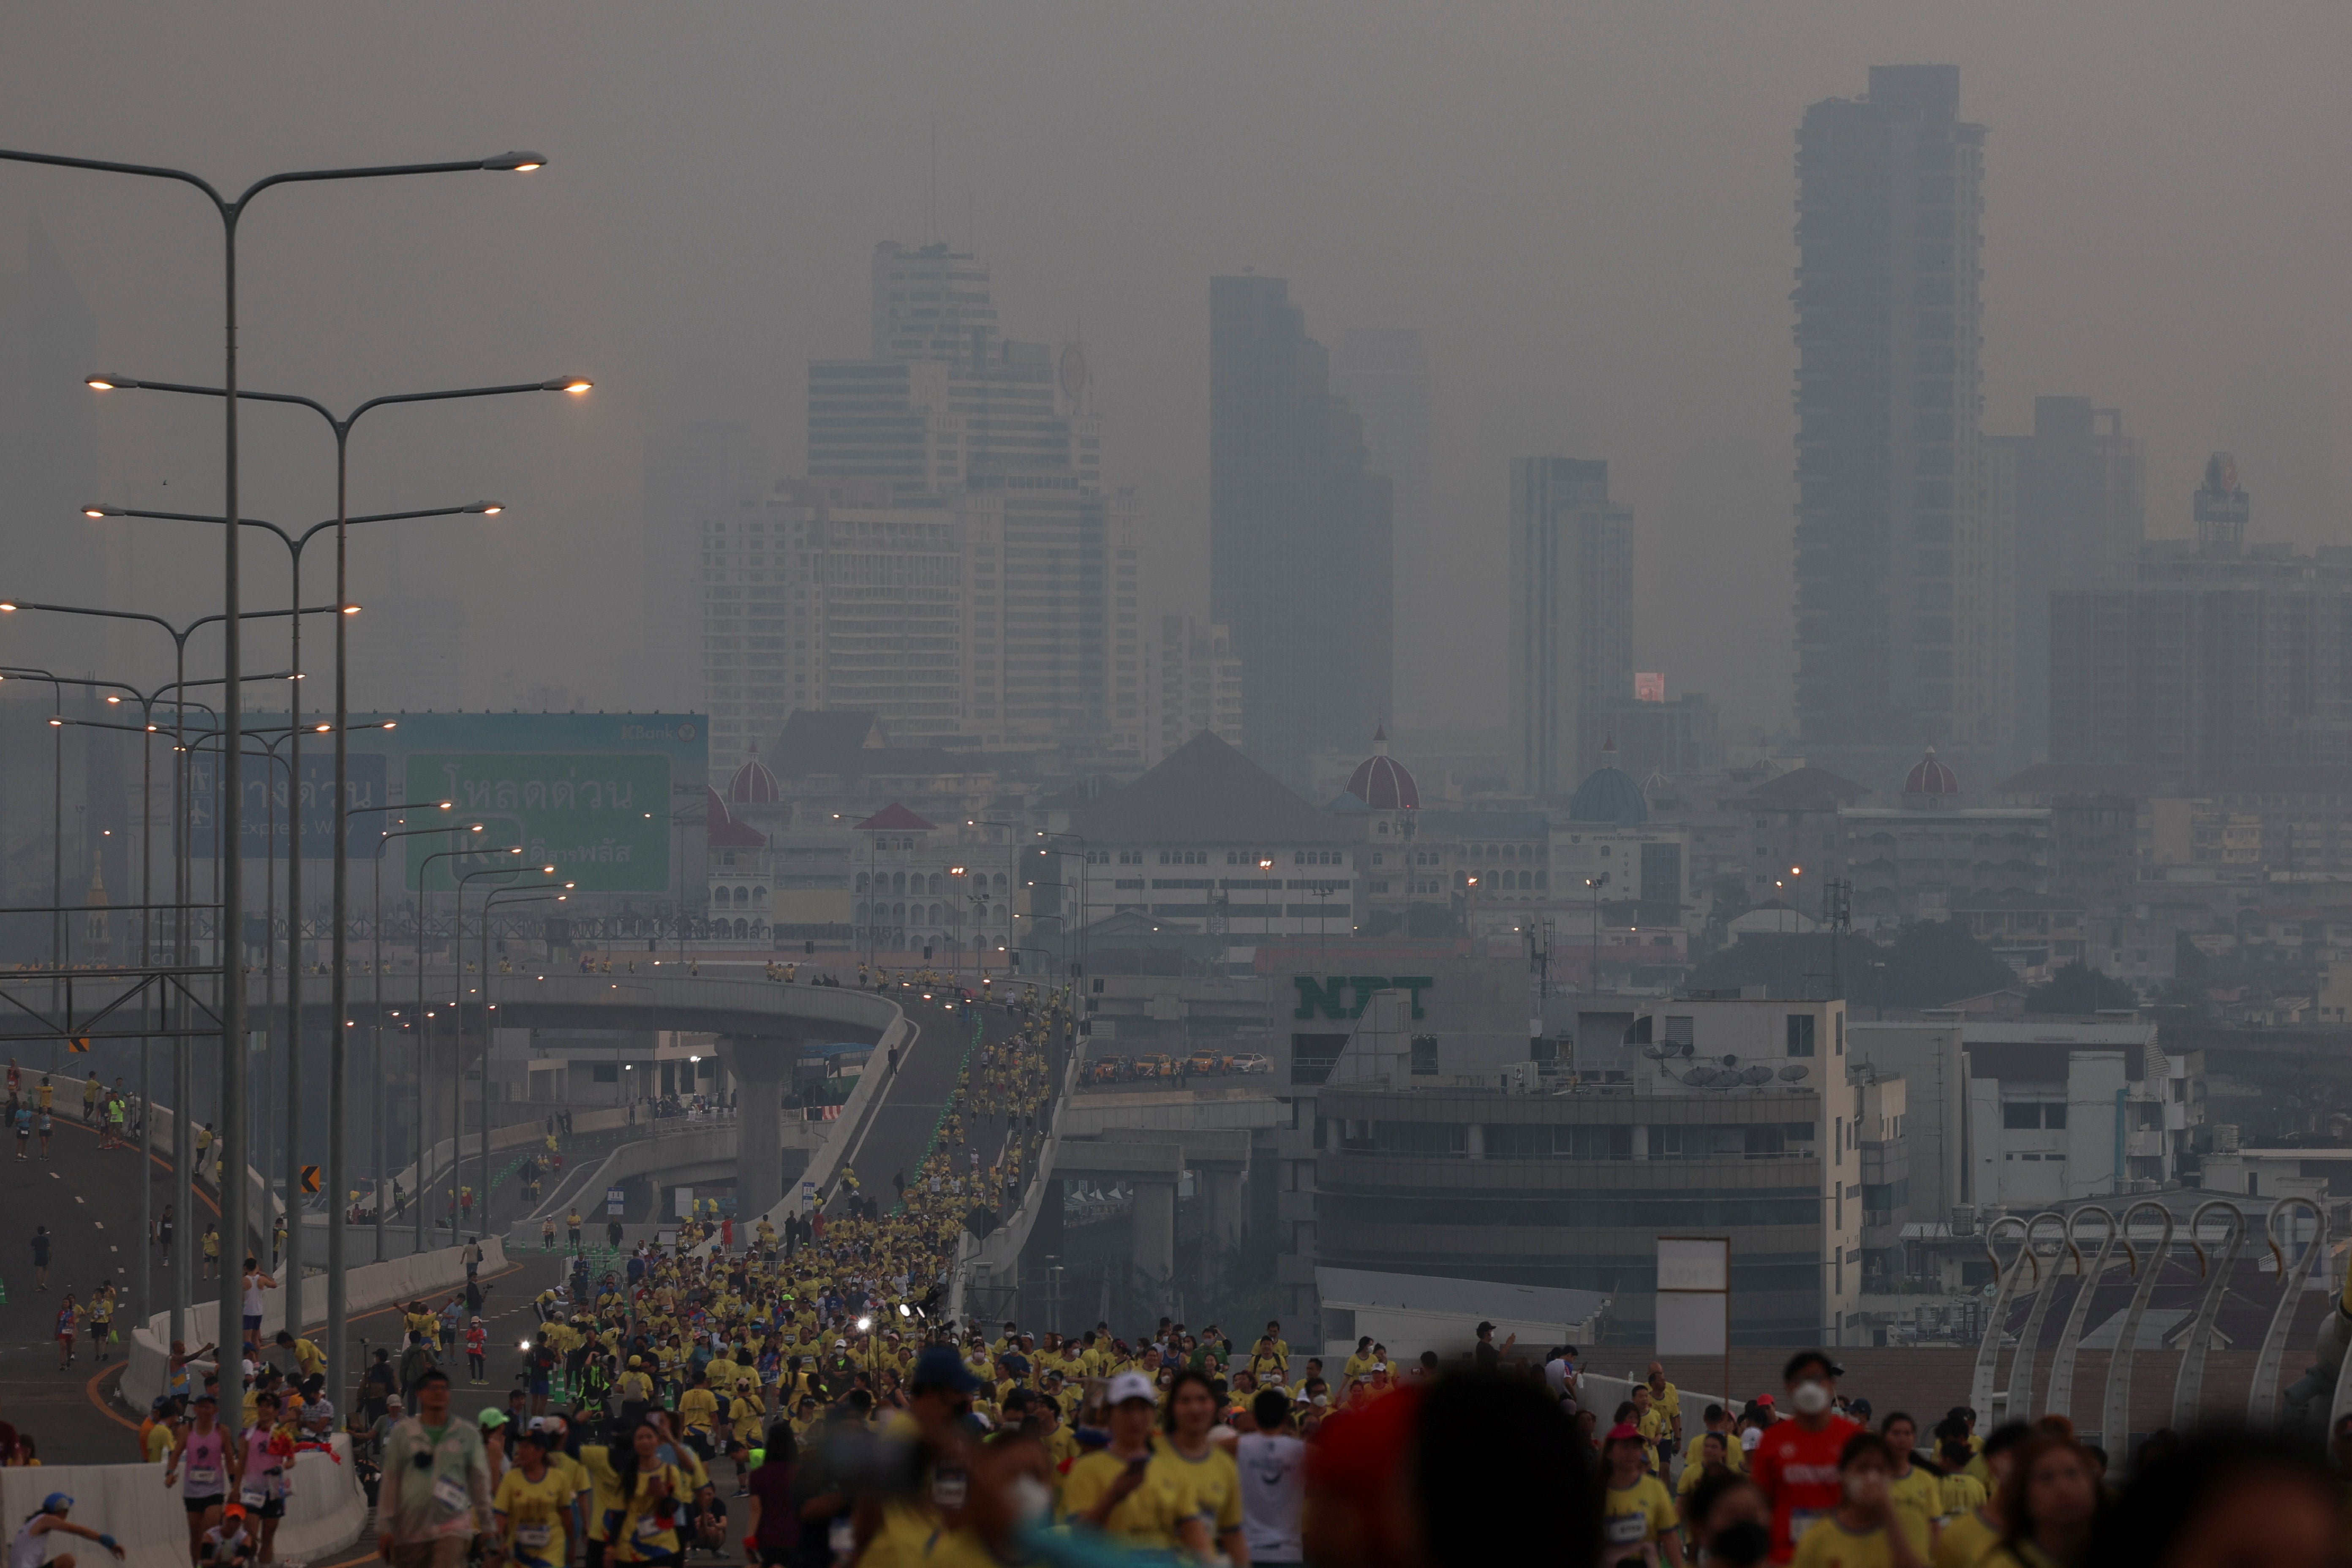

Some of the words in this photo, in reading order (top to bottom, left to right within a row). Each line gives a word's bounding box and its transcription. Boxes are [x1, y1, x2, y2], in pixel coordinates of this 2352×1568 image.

[621, 723, 674, 740] KBank
[443, 763, 633, 809] โหลดด่วน
[240, 819, 308, 837] Expres
[314, 819, 354, 838] Wy
